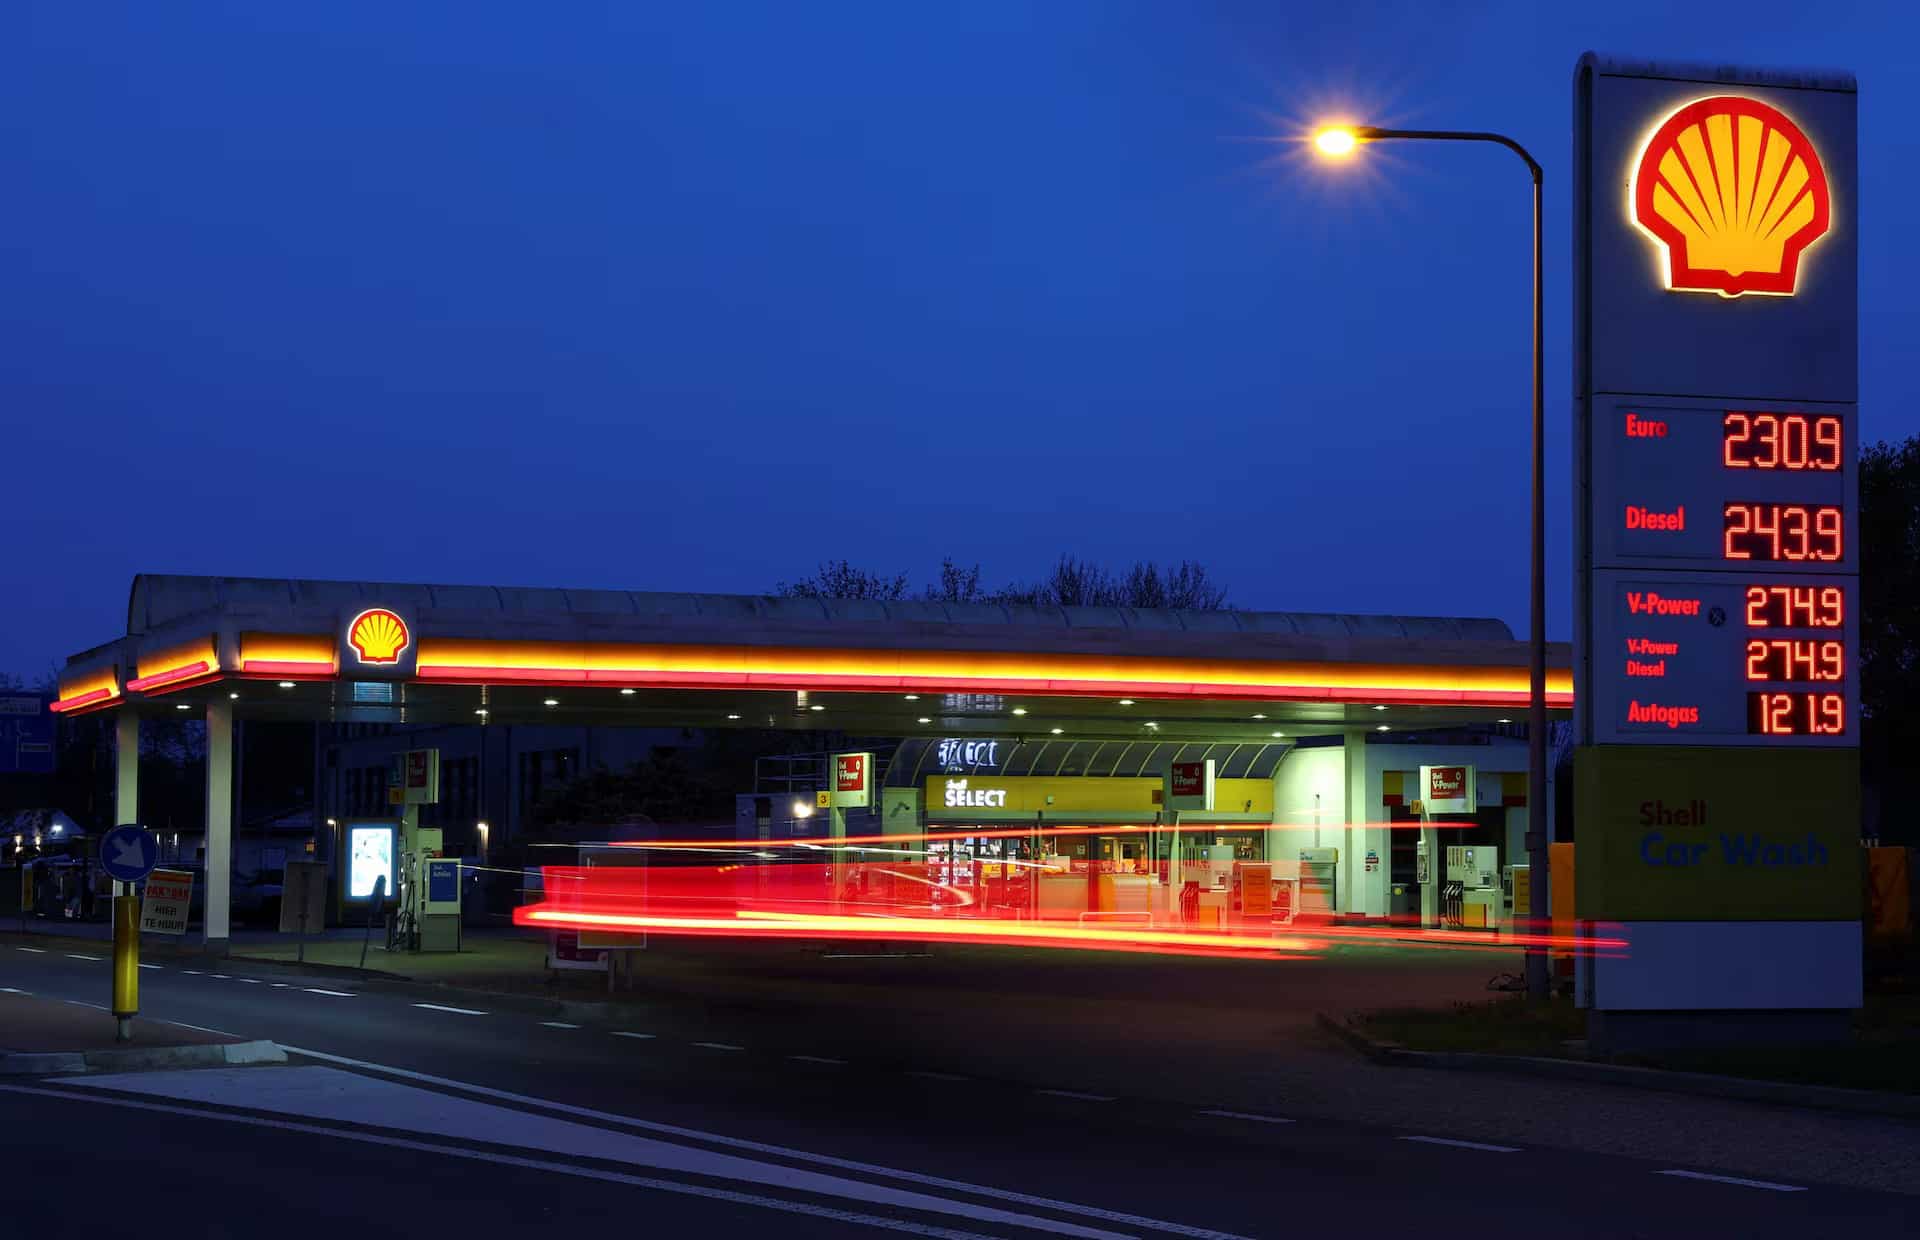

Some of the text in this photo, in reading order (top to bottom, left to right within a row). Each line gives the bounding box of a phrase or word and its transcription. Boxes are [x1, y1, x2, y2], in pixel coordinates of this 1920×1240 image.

[1626, 414, 1841, 470] Euro 230.9
[1626, 506, 1842, 561] Diesel 243.9
[1626, 587, 1842, 627] V-Power 274.9
[1626, 639, 1679, 655] V-Power
[1626, 641, 1842, 681] Diesel 274.9
[1627, 700, 1700, 728] Autogas
[819, 795, 827, 804] 3
[944, 789, 1007, 807] SELECT
[1639, 800, 1706, 827] Shell
[1639, 832, 1829, 867] Car Wash
